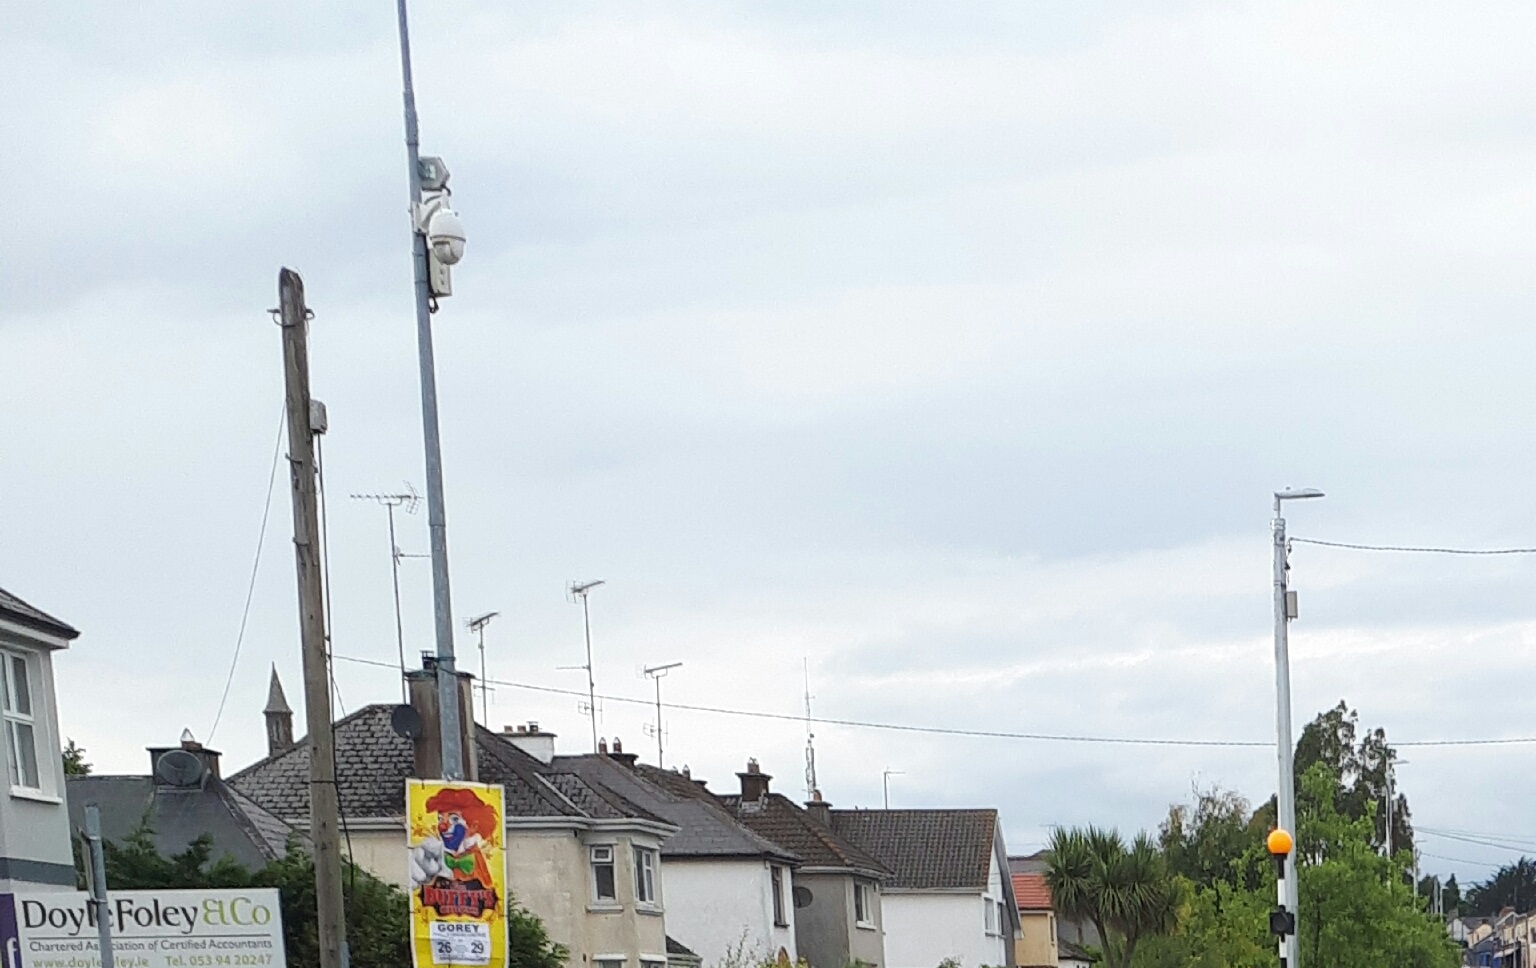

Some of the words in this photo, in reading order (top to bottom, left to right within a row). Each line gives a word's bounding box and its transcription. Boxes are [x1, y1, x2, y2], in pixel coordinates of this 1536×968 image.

[437, 923, 480, 933] GOREY
[29, 941, 83, 952] Chartered
[85, 940, 145, 951] Asciation
[149, 940, 161, 952] of
[160, 939, 206, 950] Certified
[208, 939, 273, 950] Accountants
[437, 941, 453, 954] 26
[471, 942, 485, 954] 29
[165, 955, 187, 967] Tel.
[190, 955, 212, 966] 053
[215, 955, 232, 966] 94
[234, 954, 273, 965] 20247
